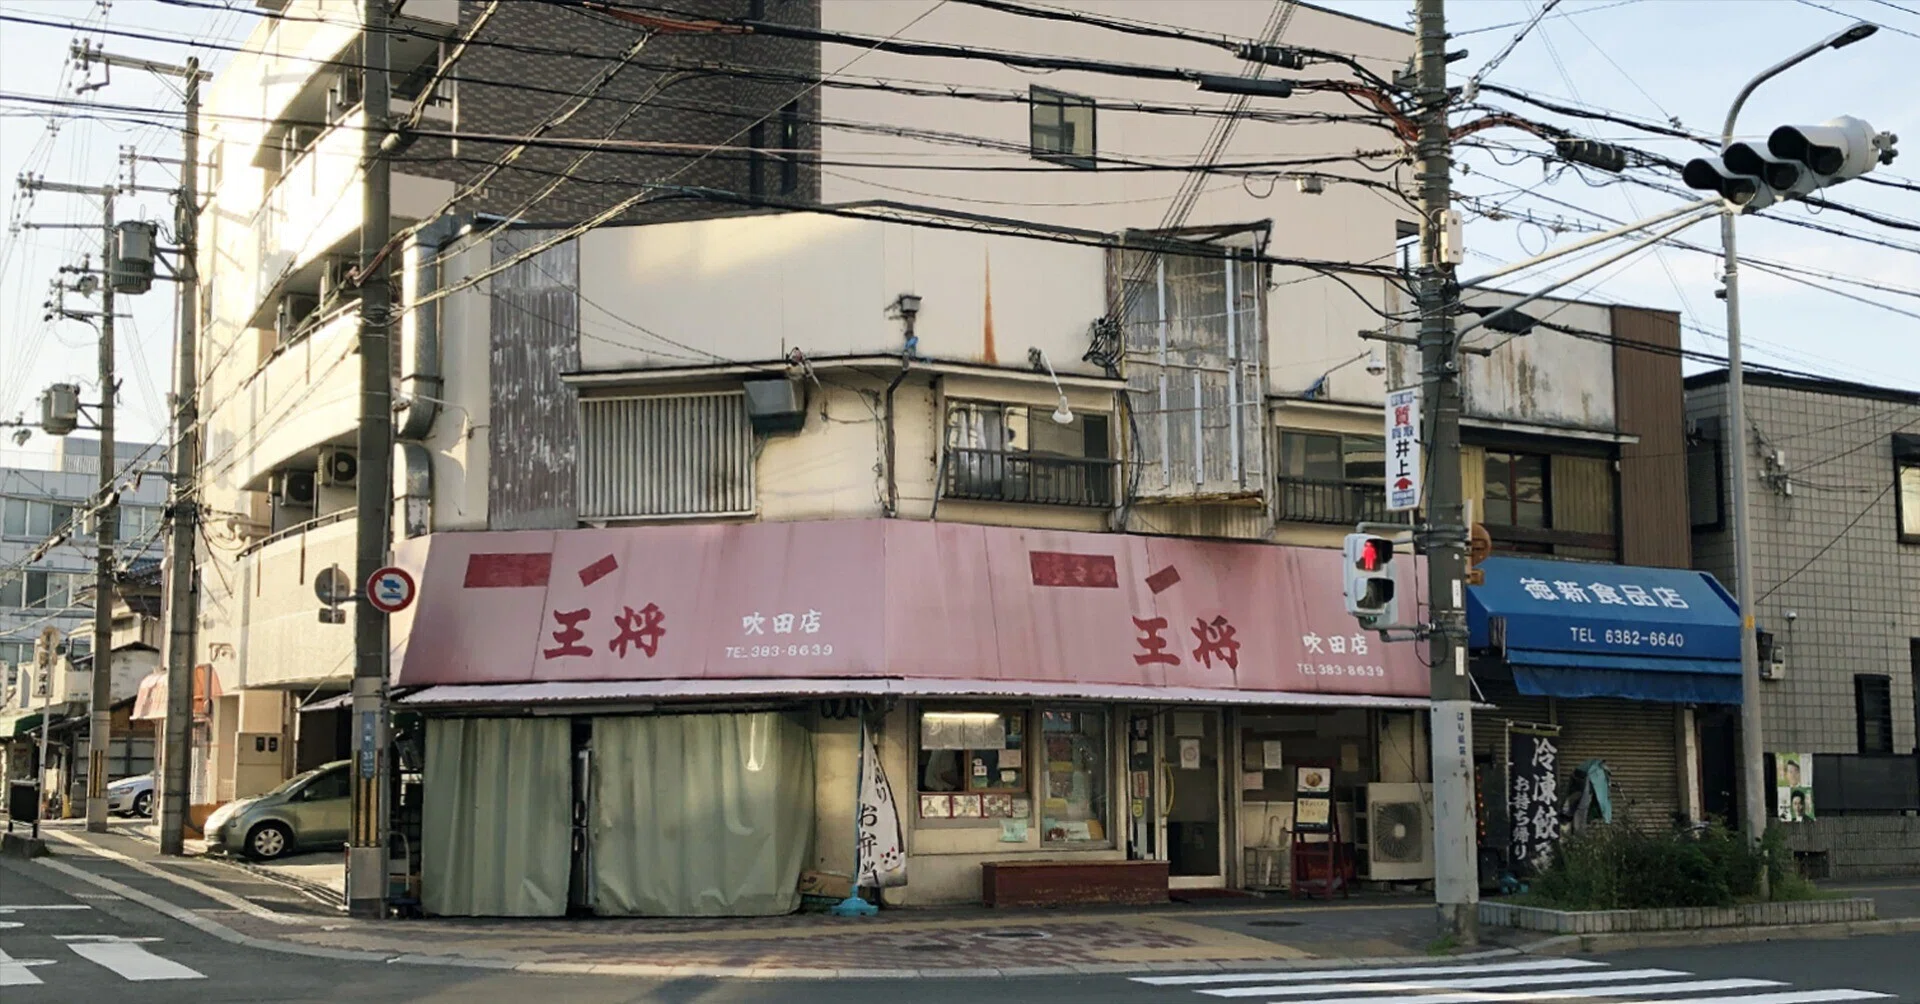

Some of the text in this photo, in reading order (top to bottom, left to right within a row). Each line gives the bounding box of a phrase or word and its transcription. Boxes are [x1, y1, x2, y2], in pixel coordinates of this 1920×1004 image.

[1395, 440, 1410, 477] 井上
[1520, 577, 1689, 609] 徳新食品店
[543, 602, 667, 660] 王将
[742, 608, 823, 635] 吹田店
[1570, 626, 1685, 648] TEL 6382-6640
[725, 643, 834, 658] TEL 383-8639
[1132, 614, 1241, 670] 王将
[1302, 631, 1368, 655] 吹田店
[1296, 662, 1316, 675] TEL
[1513, 775, 1530, 860] お持ち帰り
[858, 803, 880, 886] お弁当
